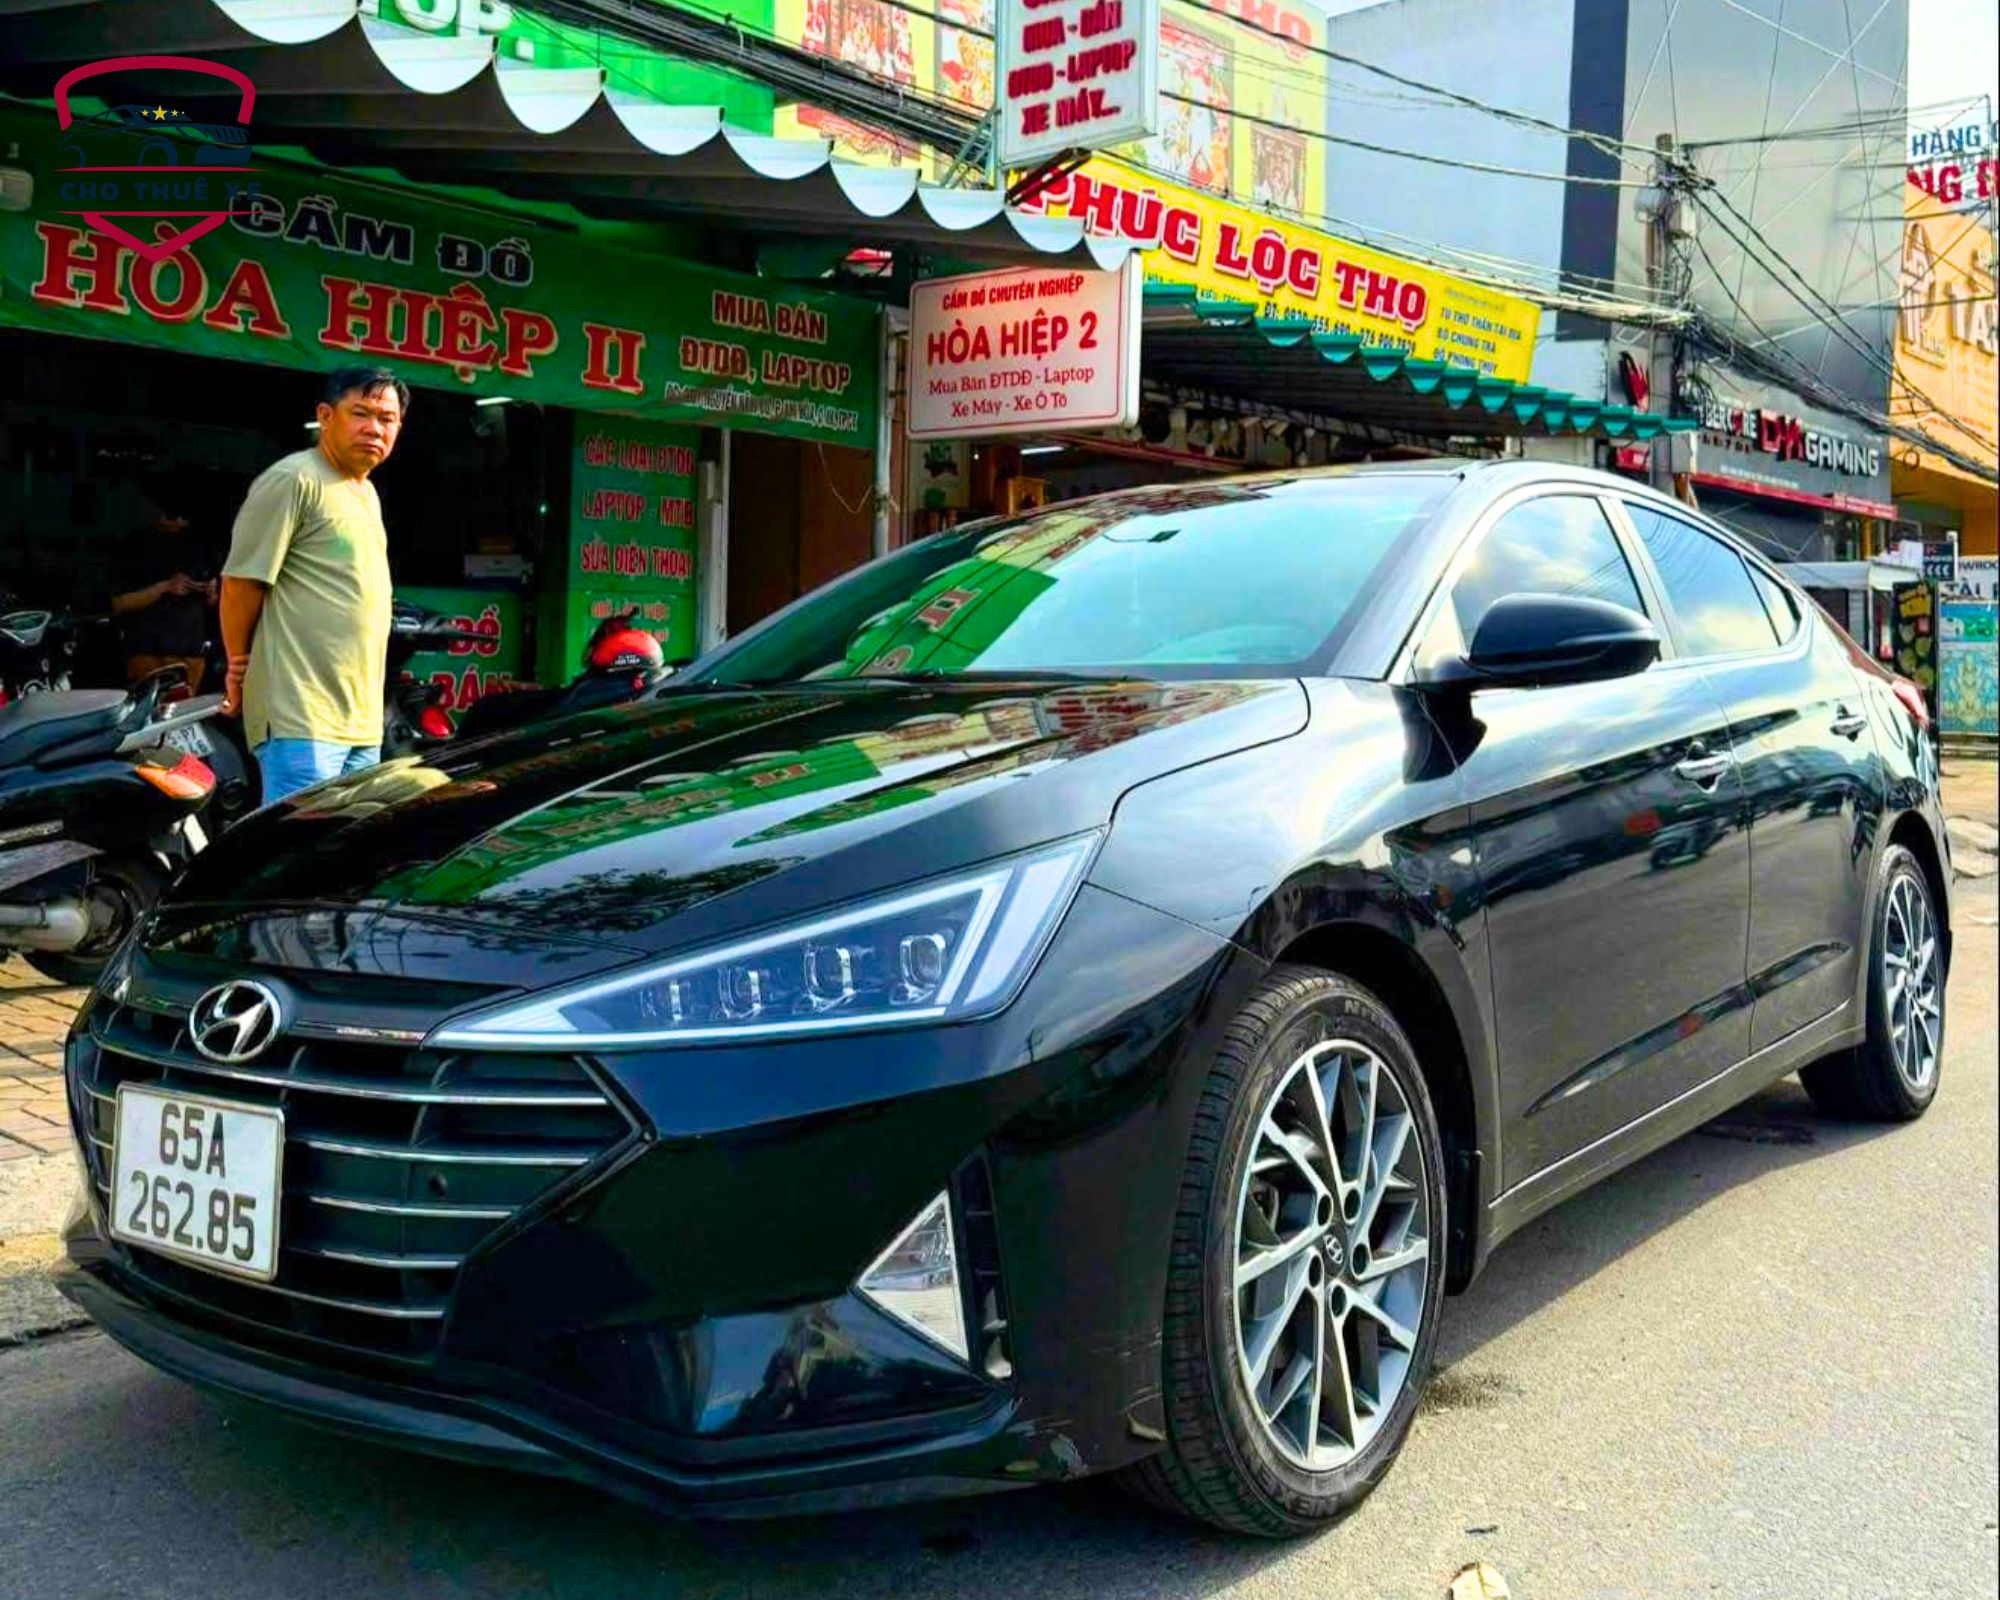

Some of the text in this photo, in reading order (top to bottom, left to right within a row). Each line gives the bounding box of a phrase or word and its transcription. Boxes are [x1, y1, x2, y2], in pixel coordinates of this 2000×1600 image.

[1021, 103, 1050, 135] XE
[1213, 221, 1321, 297] LỘC
[1331, 258, 1428, 332] THỌ
[32, 221, 645, 394] HÒA HIỆP II
[712, 289, 828, 345] MUA BÁN
[928, 307, 1098, 366] HÒA HIỆP 2
[761, 350, 851, 395] LAPTOP
[929, 379, 957, 396] Mua
[1044, 366, 1095, 386] Laptop
[952, 401, 969, 418] Xe
[1014, 395, 1033, 412] Xe
[1805, 430, 1879, 477] GAMING
[160, 1102, 226, 1178] 65A
[129, 1170, 256, 1262] 262.85
